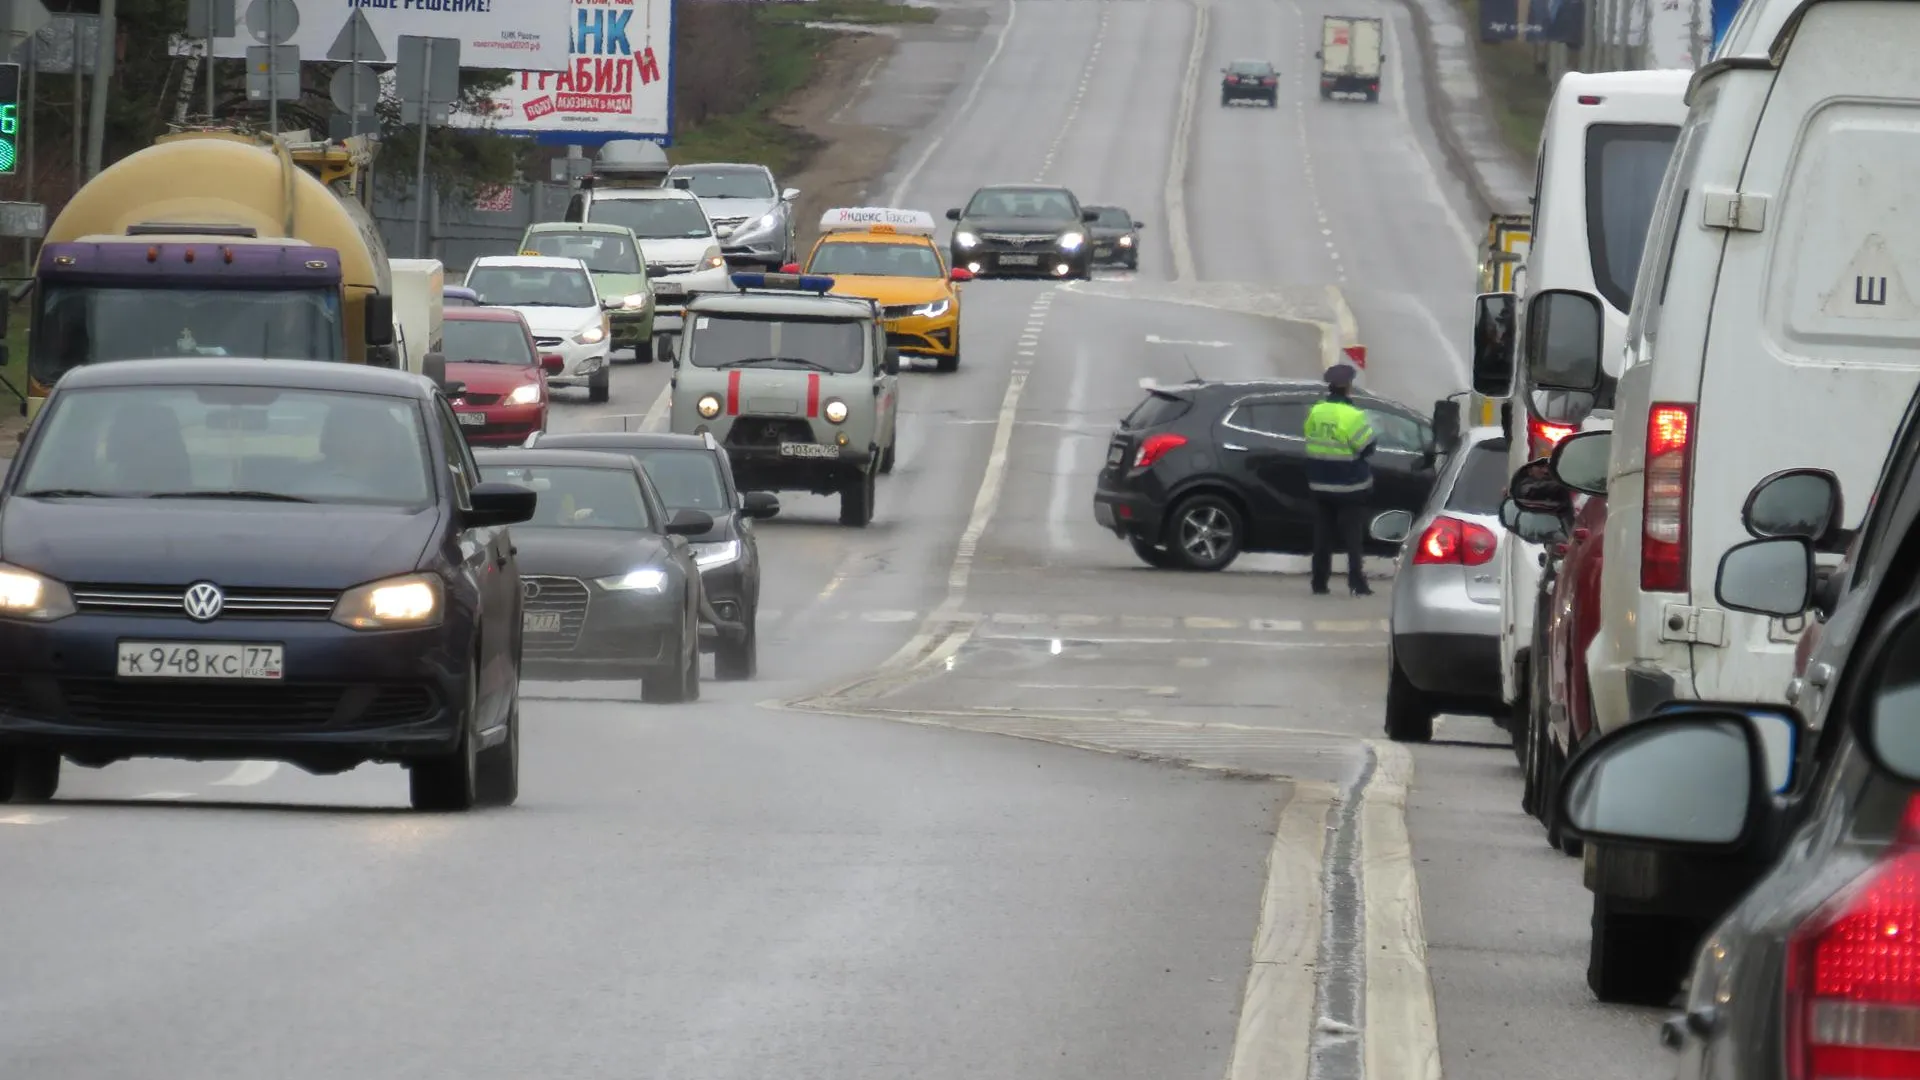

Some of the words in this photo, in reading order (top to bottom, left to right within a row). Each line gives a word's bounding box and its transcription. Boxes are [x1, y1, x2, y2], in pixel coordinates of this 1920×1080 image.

[568, 8, 634, 56] НК
[840, 210, 882, 223] Яндекс
[885, 211, 917, 224] Такси
[1856, 275, 1887, 306] Ш
[247, 648, 273, 668] 77
